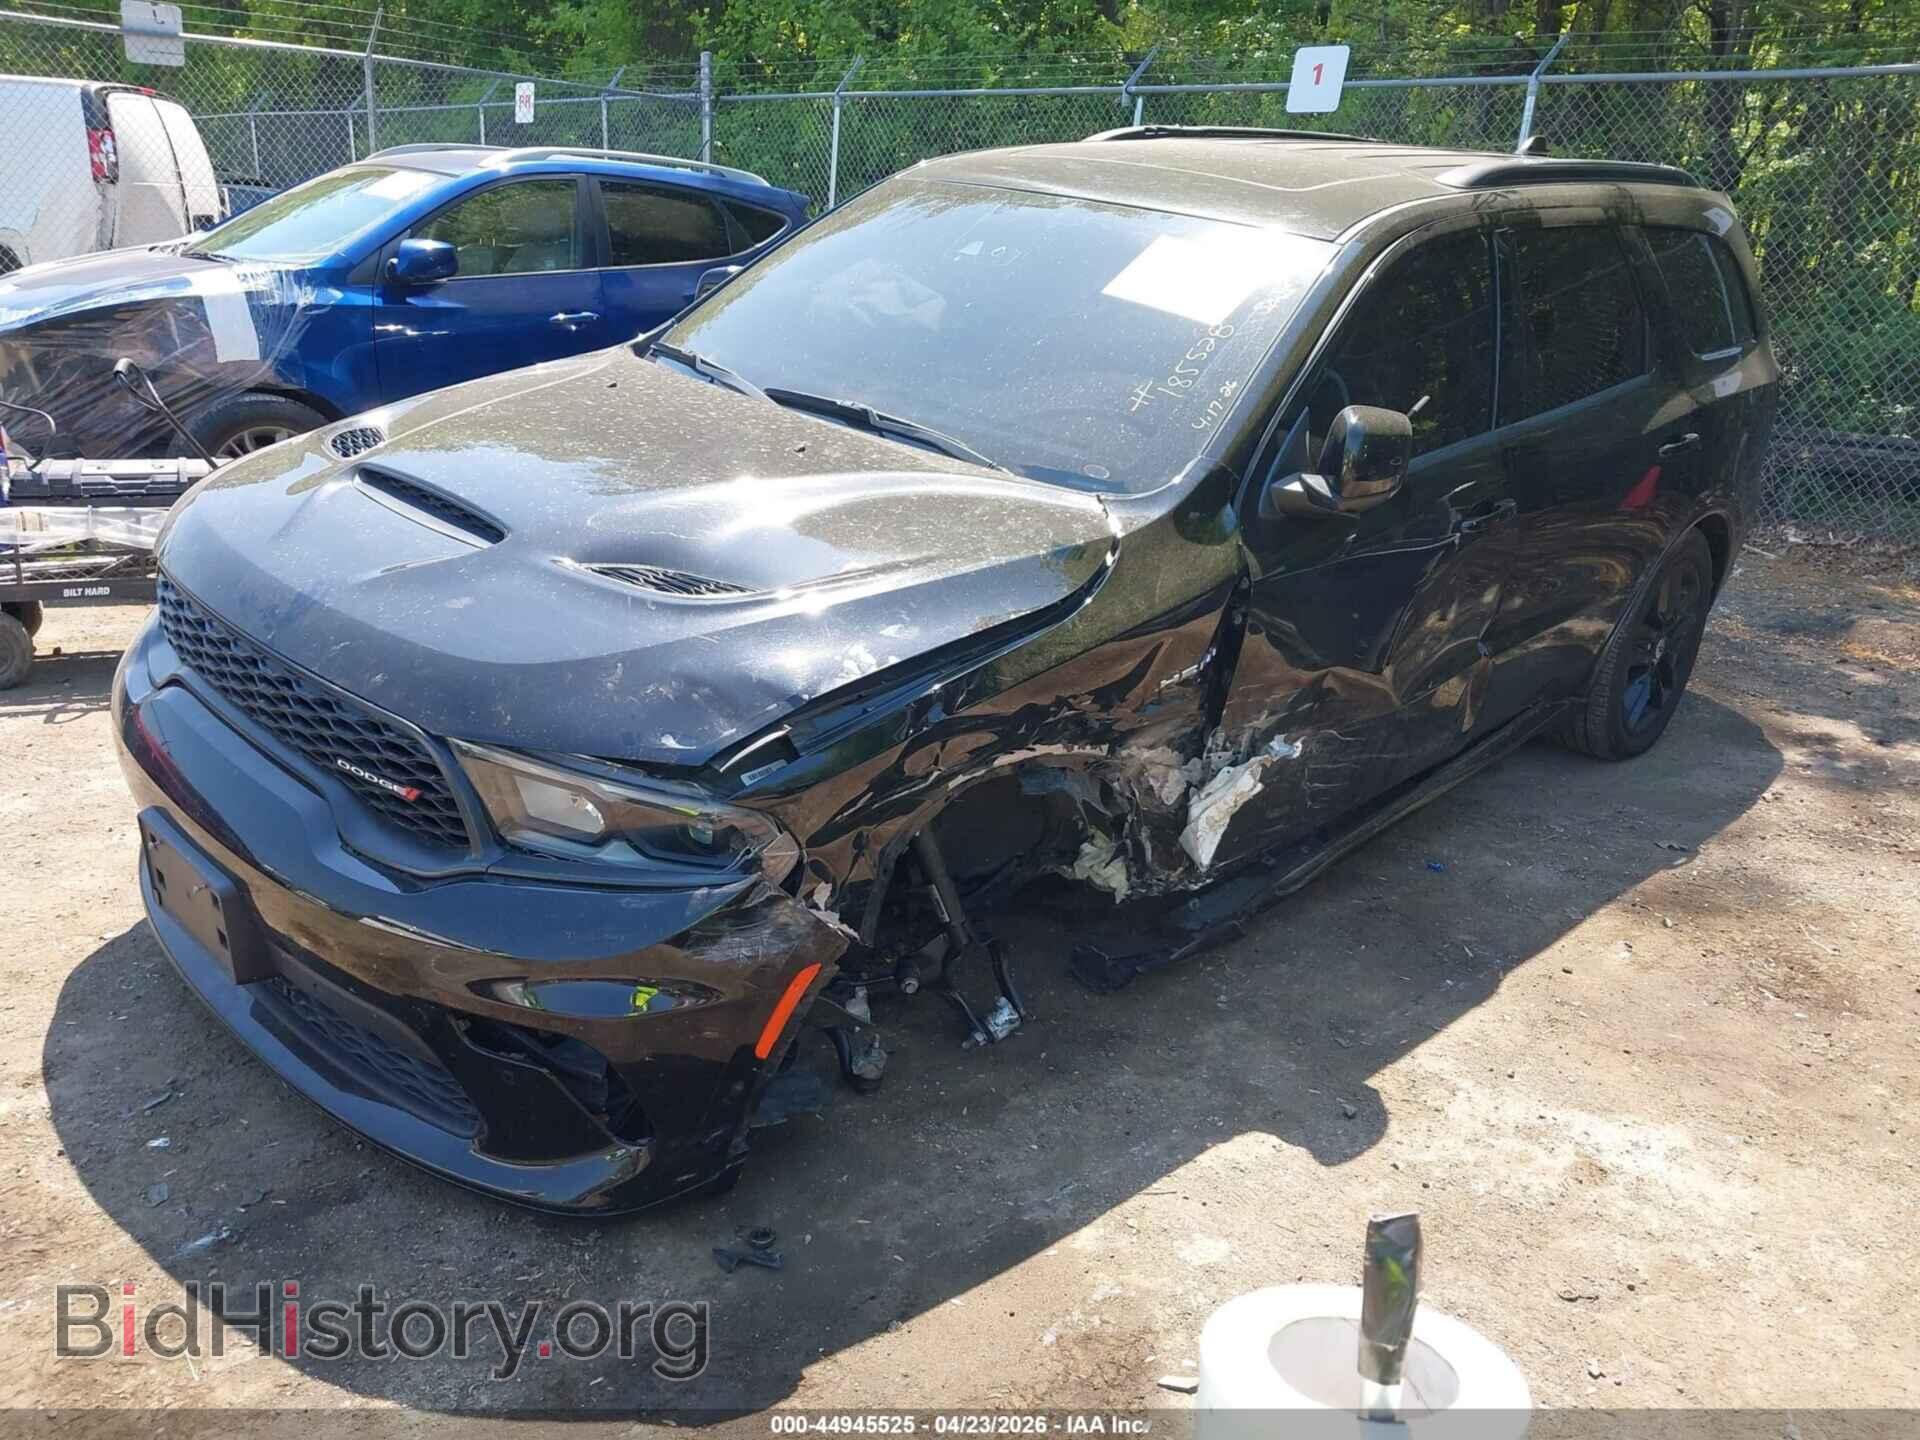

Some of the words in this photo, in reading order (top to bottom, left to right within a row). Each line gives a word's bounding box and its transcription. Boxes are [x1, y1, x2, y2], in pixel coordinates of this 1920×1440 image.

[1313, 63, 1324, 86] 1
[63, 587, 83, 598] BILT
[84, 586, 110, 597] HARD
[336, 759, 407, 797] DODGE
